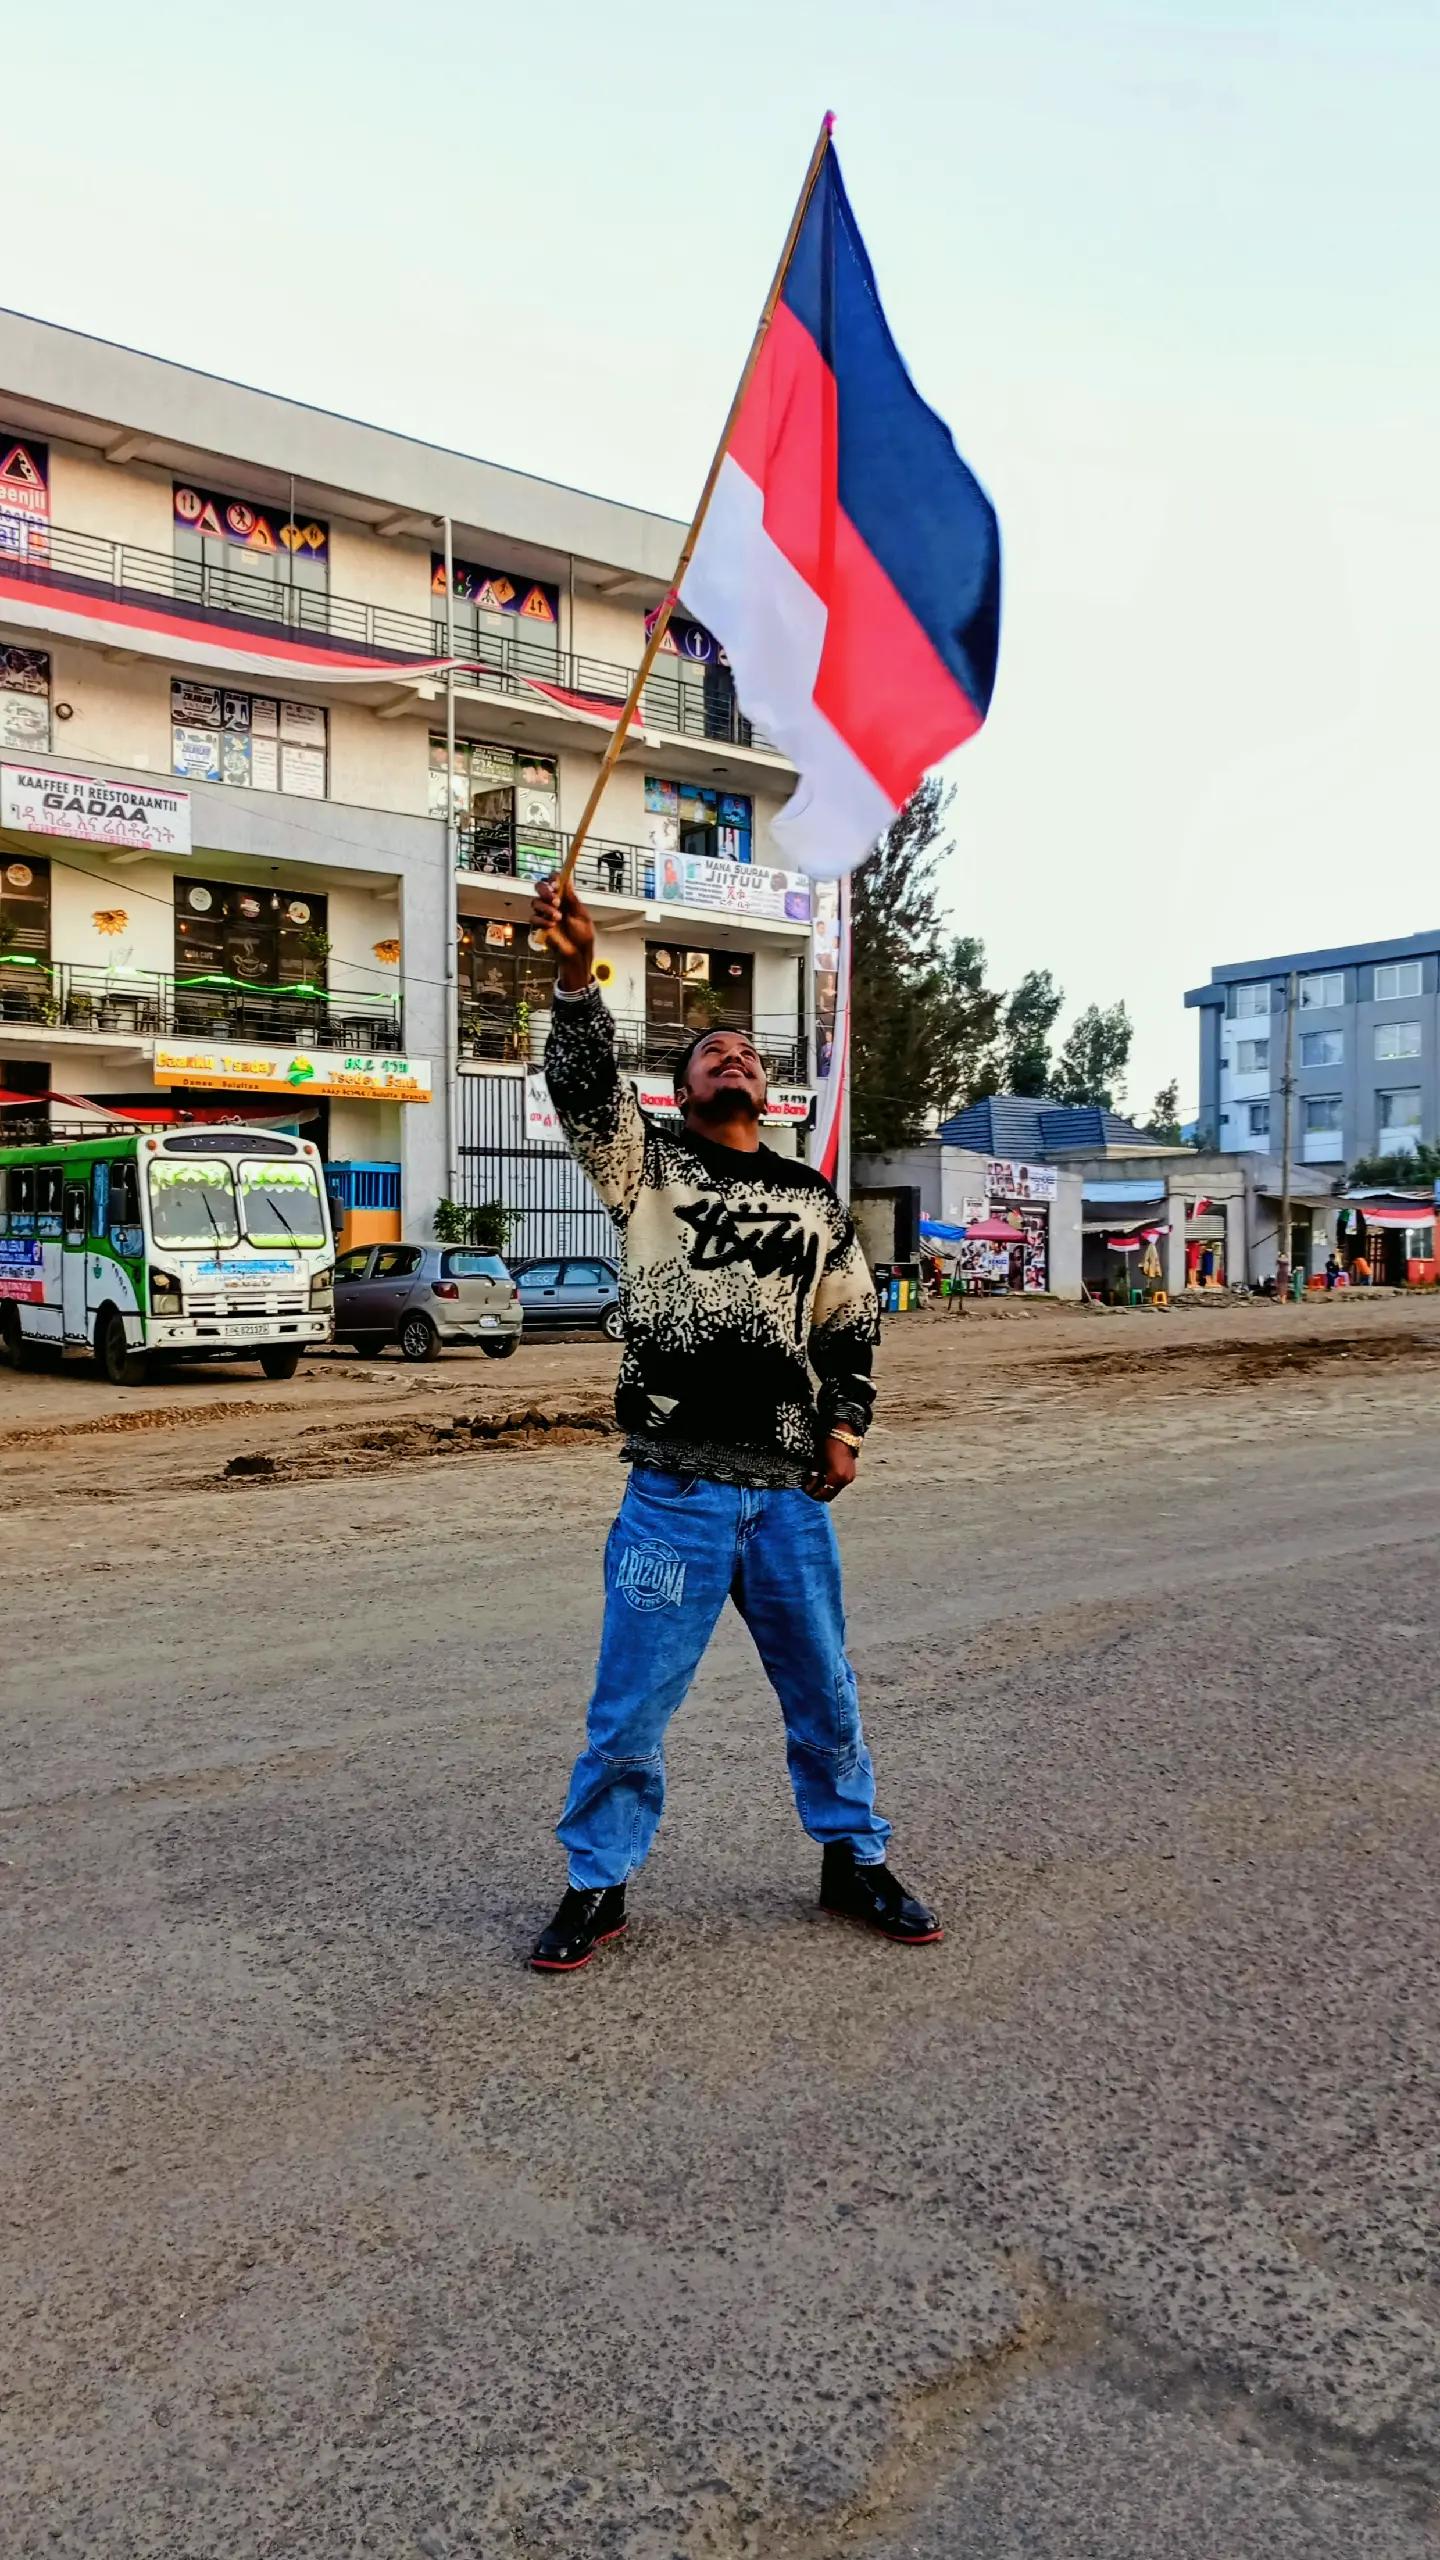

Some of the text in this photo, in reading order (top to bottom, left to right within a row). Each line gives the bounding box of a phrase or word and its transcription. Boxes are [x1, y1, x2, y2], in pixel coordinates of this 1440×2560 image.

[18, 775, 177, 812] KAAFFEE FI REESTORAANTII
[43, 793, 148, 824] GADAA
[705, 870, 762, 889] JIITUU
[384, 1074, 418, 1088] Bank
[401, 1092, 428, 1101] Branch
[640, 1092, 676, 1106] Baank
[783, 1103, 807, 1115] Bank
[616, 1546, 687, 1607] ARIZONA
